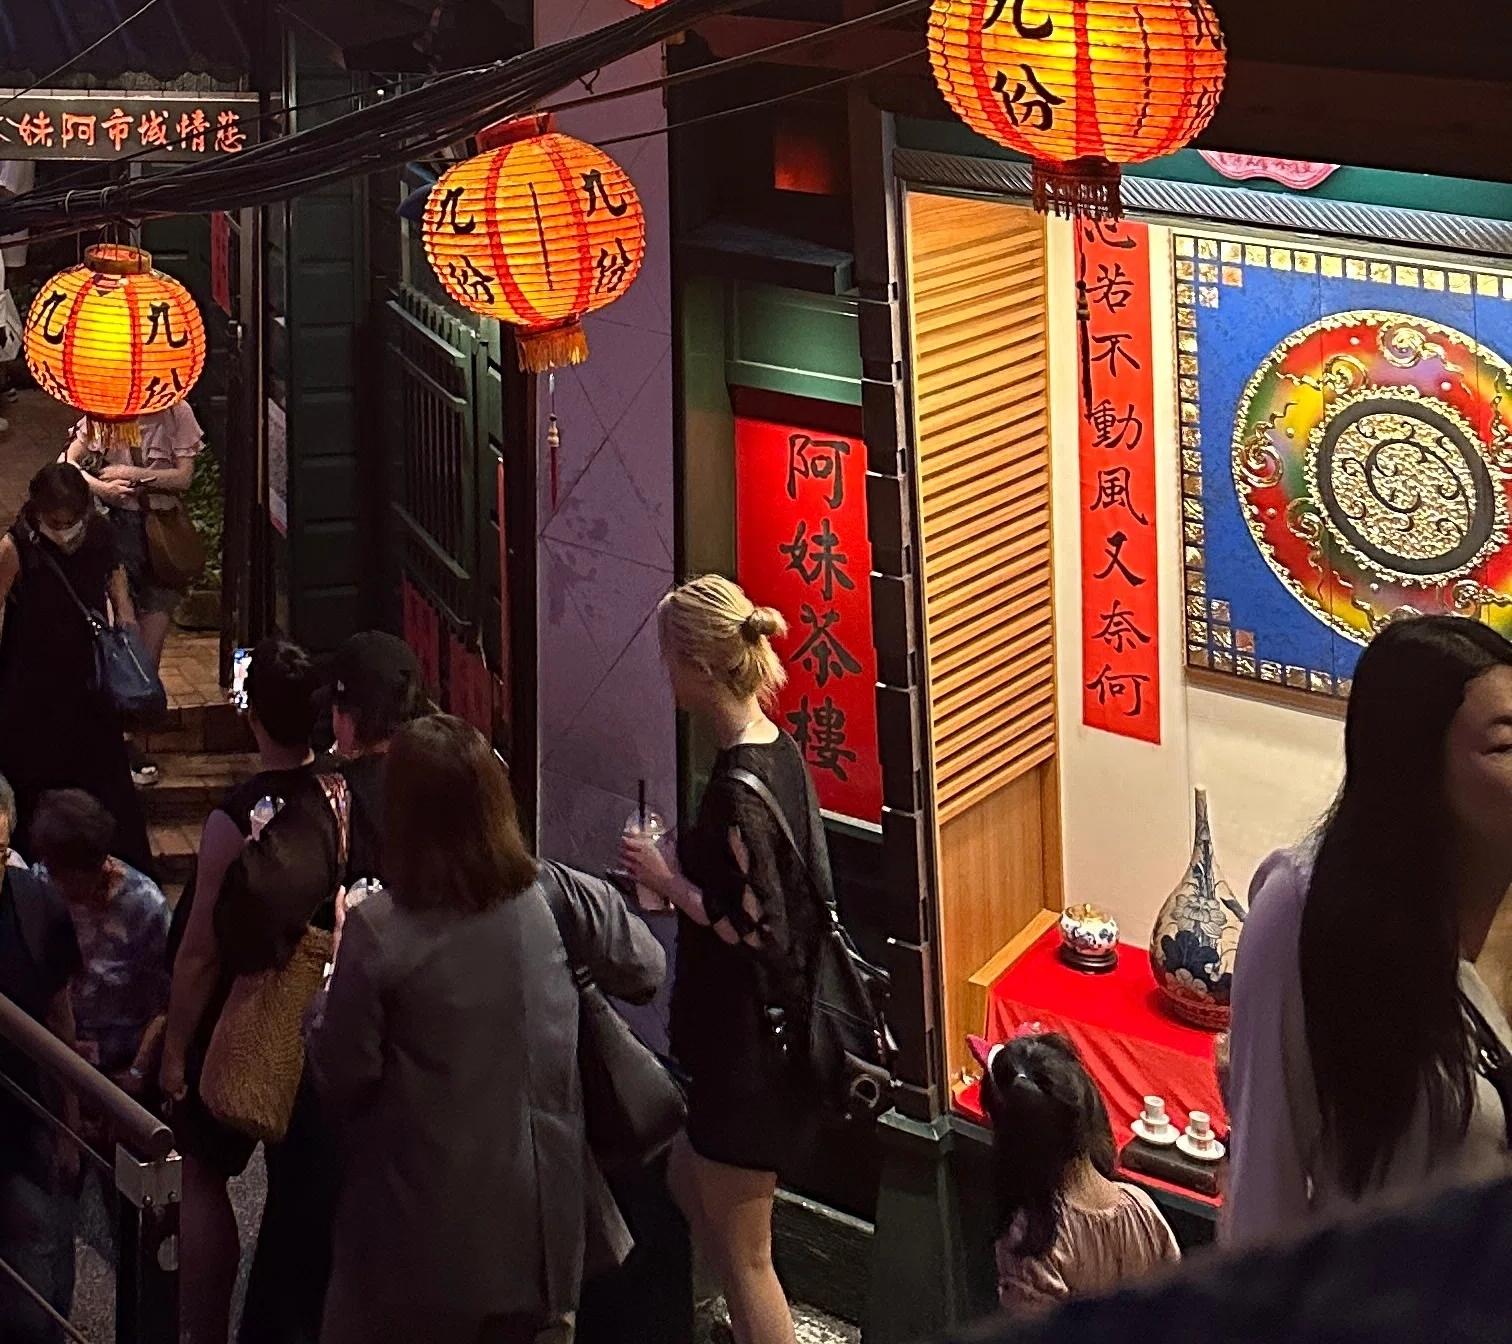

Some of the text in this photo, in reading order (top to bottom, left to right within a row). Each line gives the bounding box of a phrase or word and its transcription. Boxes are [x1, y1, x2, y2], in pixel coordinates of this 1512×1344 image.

[436, 187, 495, 305] 九份
[581, 168, 634, 295] 九份
[141, 301, 189, 410] 九份
[1085, 216, 1153, 718] 心若不動風又奈何
[778, 433, 863, 784] 阿妹茶樓
